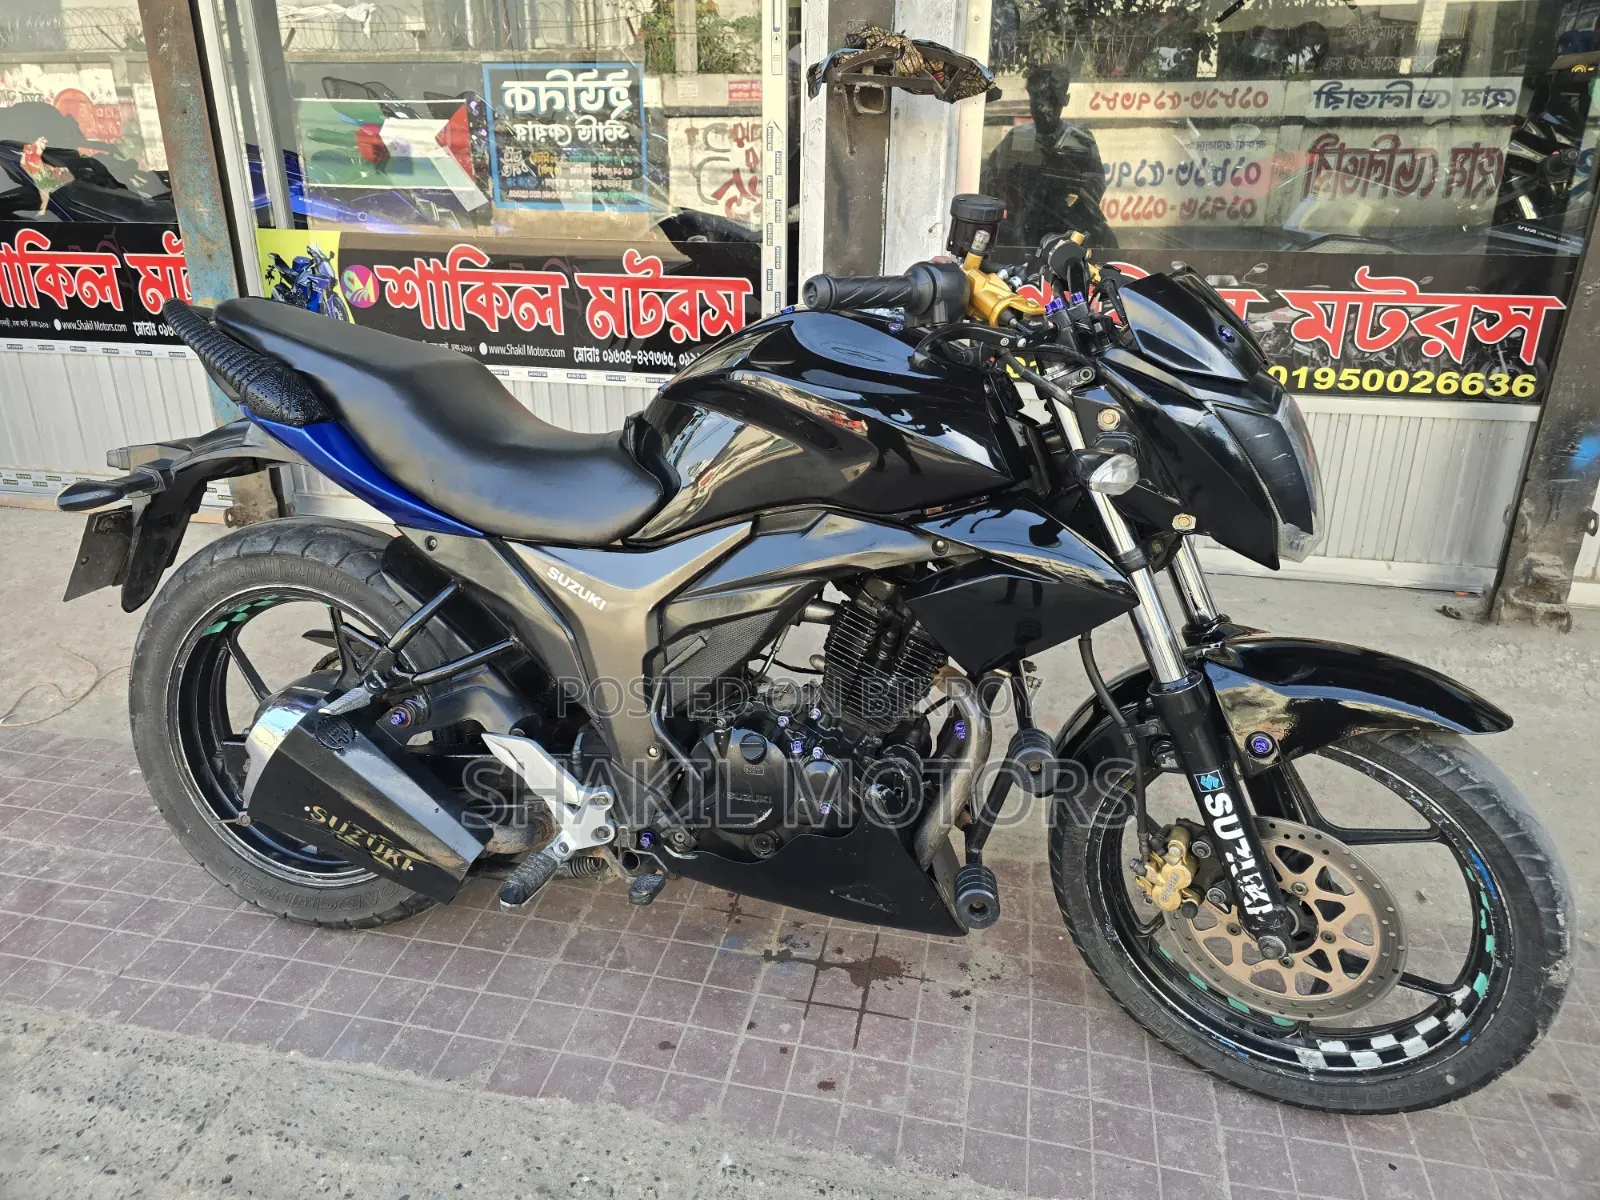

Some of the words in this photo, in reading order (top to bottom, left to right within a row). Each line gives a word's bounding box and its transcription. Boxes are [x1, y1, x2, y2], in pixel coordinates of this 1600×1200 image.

[374, 243, 569, 336] শাকিল
[575, 248, 753, 345] মটরস
[1275, 266, 1567, 366] মটরস
[1267, 366, 1537, 397] 01950026636
[546, 566, 607, 611] SUZUKI
[309, 805, 412, 872] SUZUKI
[1204, 792, 1273, 915] SUZUKI
[231, 864, 401, 914] OADGRIPPER
